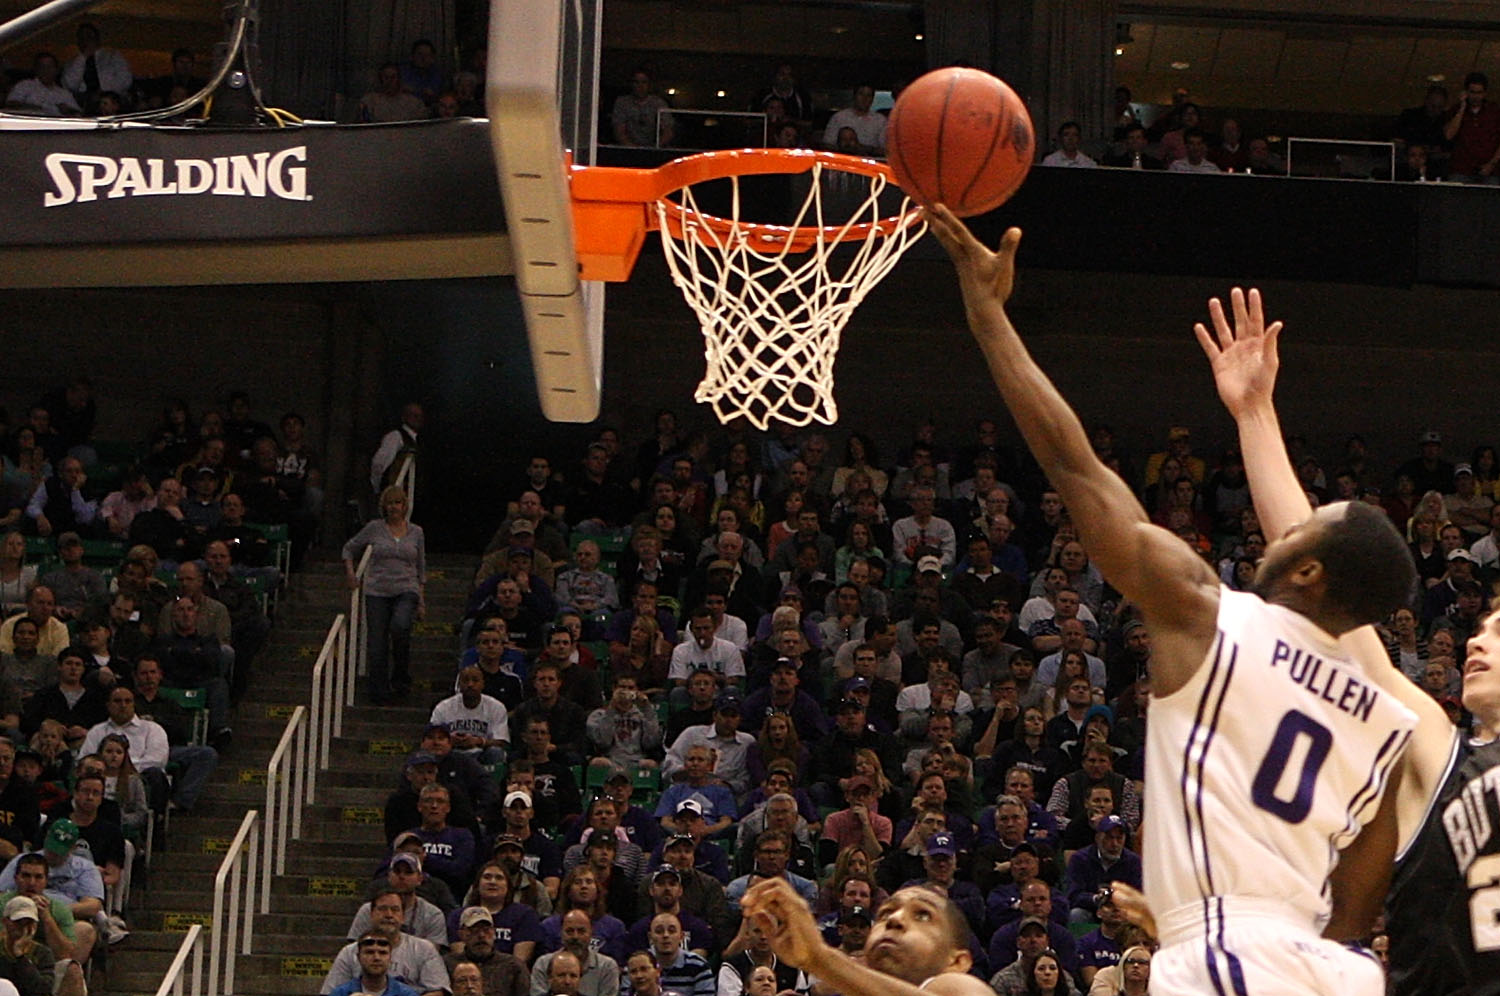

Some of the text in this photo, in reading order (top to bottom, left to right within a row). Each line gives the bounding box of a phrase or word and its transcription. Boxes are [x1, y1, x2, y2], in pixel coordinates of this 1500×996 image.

[44, 145, 309, 207] SPALDING
[1270, 638, 1379, 724] PULLEN
[1251, 708, 1334, 825] 0
